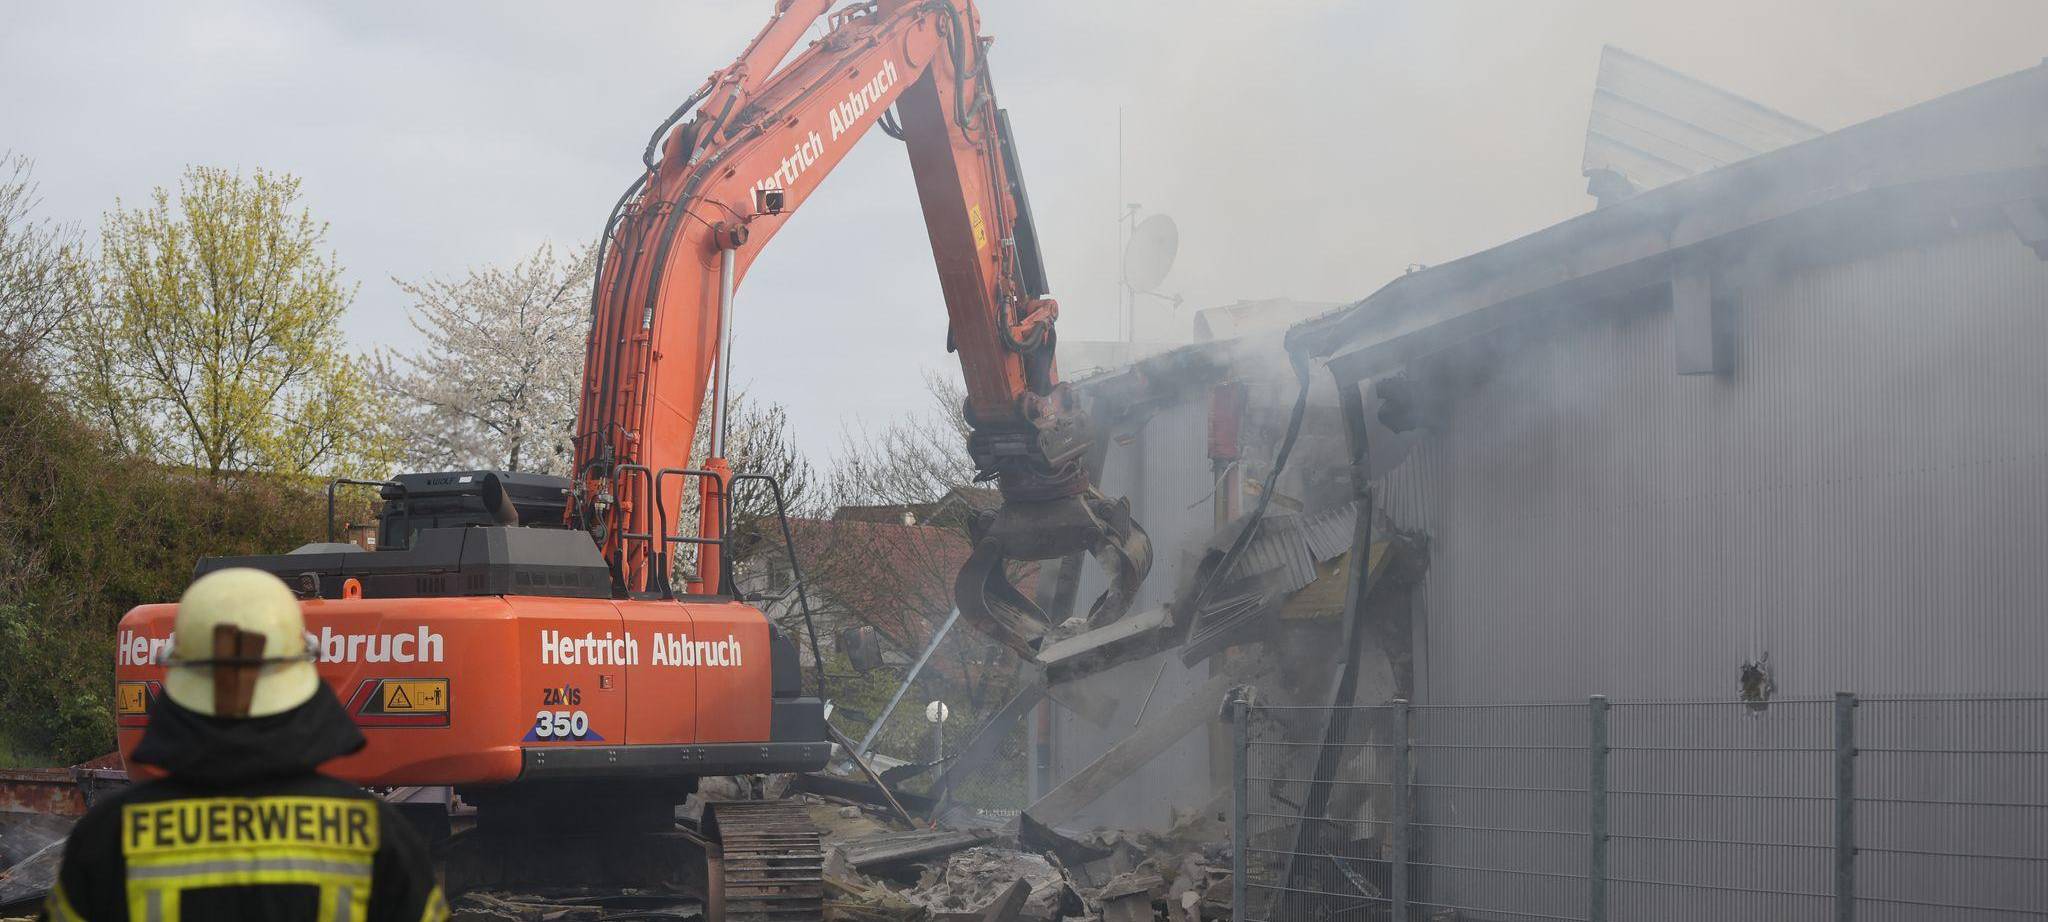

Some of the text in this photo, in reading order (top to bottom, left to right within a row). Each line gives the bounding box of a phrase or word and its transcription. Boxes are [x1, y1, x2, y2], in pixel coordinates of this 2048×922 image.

[828, 58, 899, 143] Abbruch
[311, 625, 444, 664] bruch
[541, 629, 742, 667] Hertrich Abbruch
[543, 683, 581, 706] ZAXIS
[535, 710, 589, 738] 350
[130, 803, 373, 847] FEUERWEHR
